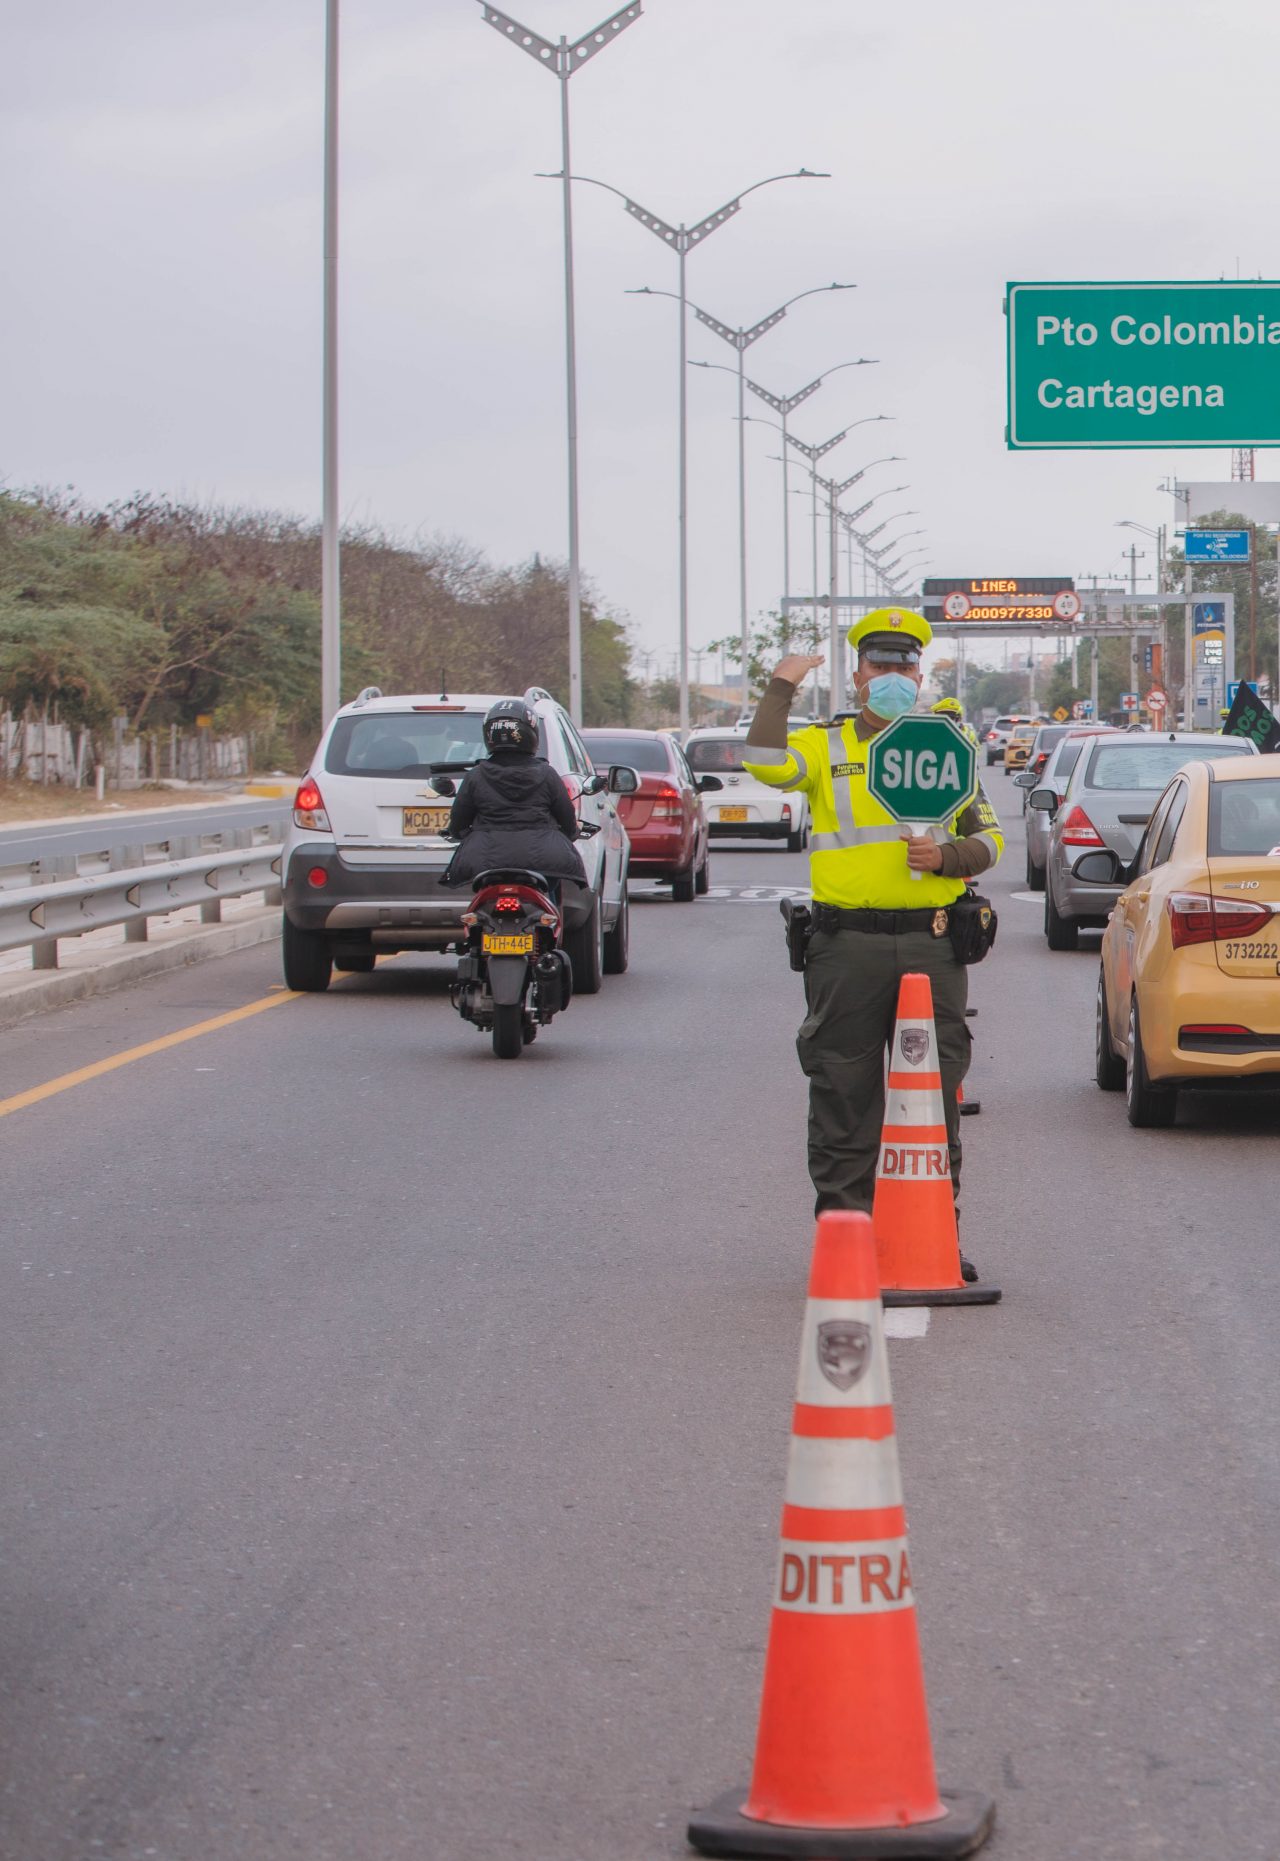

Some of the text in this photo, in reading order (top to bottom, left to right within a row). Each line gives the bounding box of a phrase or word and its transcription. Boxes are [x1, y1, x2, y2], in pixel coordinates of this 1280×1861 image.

[1036, 316, 1098, 346] Pto
[1037, 378, 1225, 415] Cartagena
[971, 580, 1017, 593] LINEA
[881, 748, 961, 790] SIGA
[1225, 943, 1279, 959] 3732222
